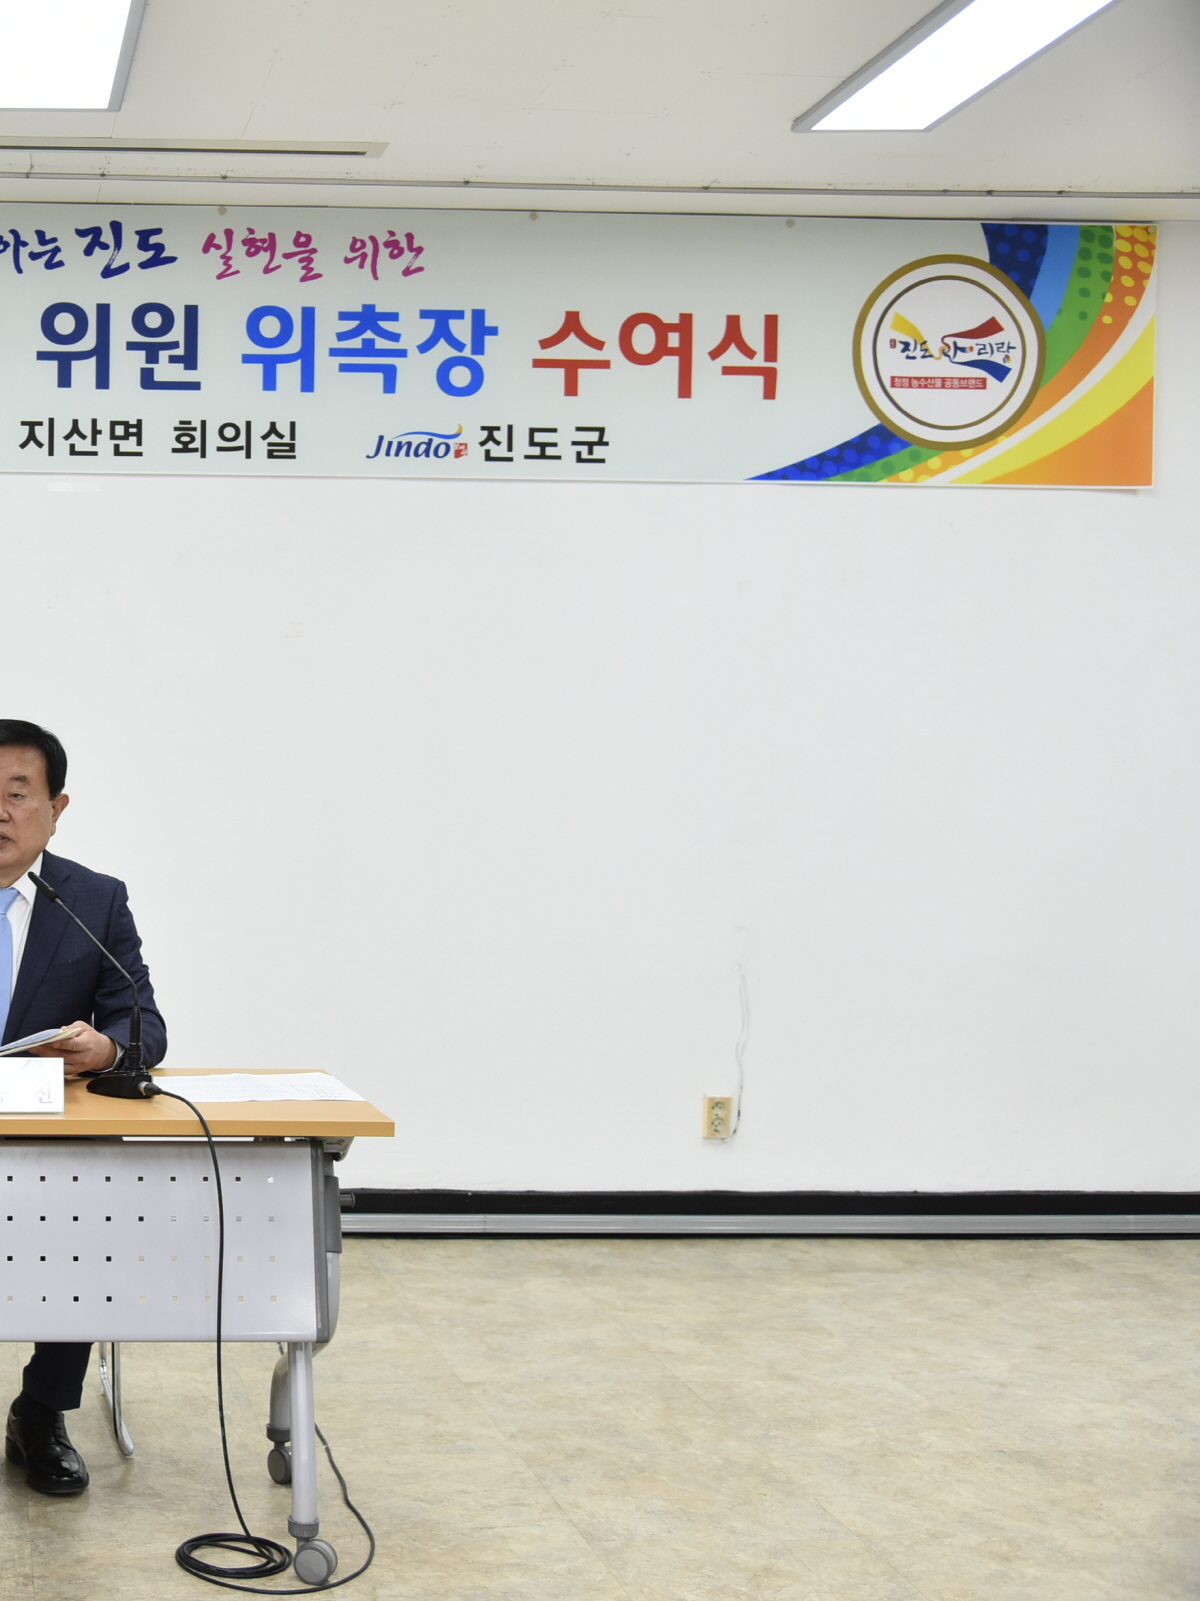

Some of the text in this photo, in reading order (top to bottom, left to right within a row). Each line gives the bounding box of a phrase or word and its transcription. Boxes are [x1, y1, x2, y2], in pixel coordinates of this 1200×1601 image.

[75, 220, 178, 279] 진도
[202, 228, 322, 282] 실현을
[344, 230, 425, 280] 위한
[36, 301, 201, 391] 위원
[241, 303, 498, 397] 위촉장
[532, 311, 779, 400] 수여식
[911, 377, 942, 388] 농수산물
[18, 417, 144, 457] 지산면
[171, 419, 297, 460] 회의실
[365, 435, 451, 459] Jindo
[478, 423, 610, 464] 진도군
